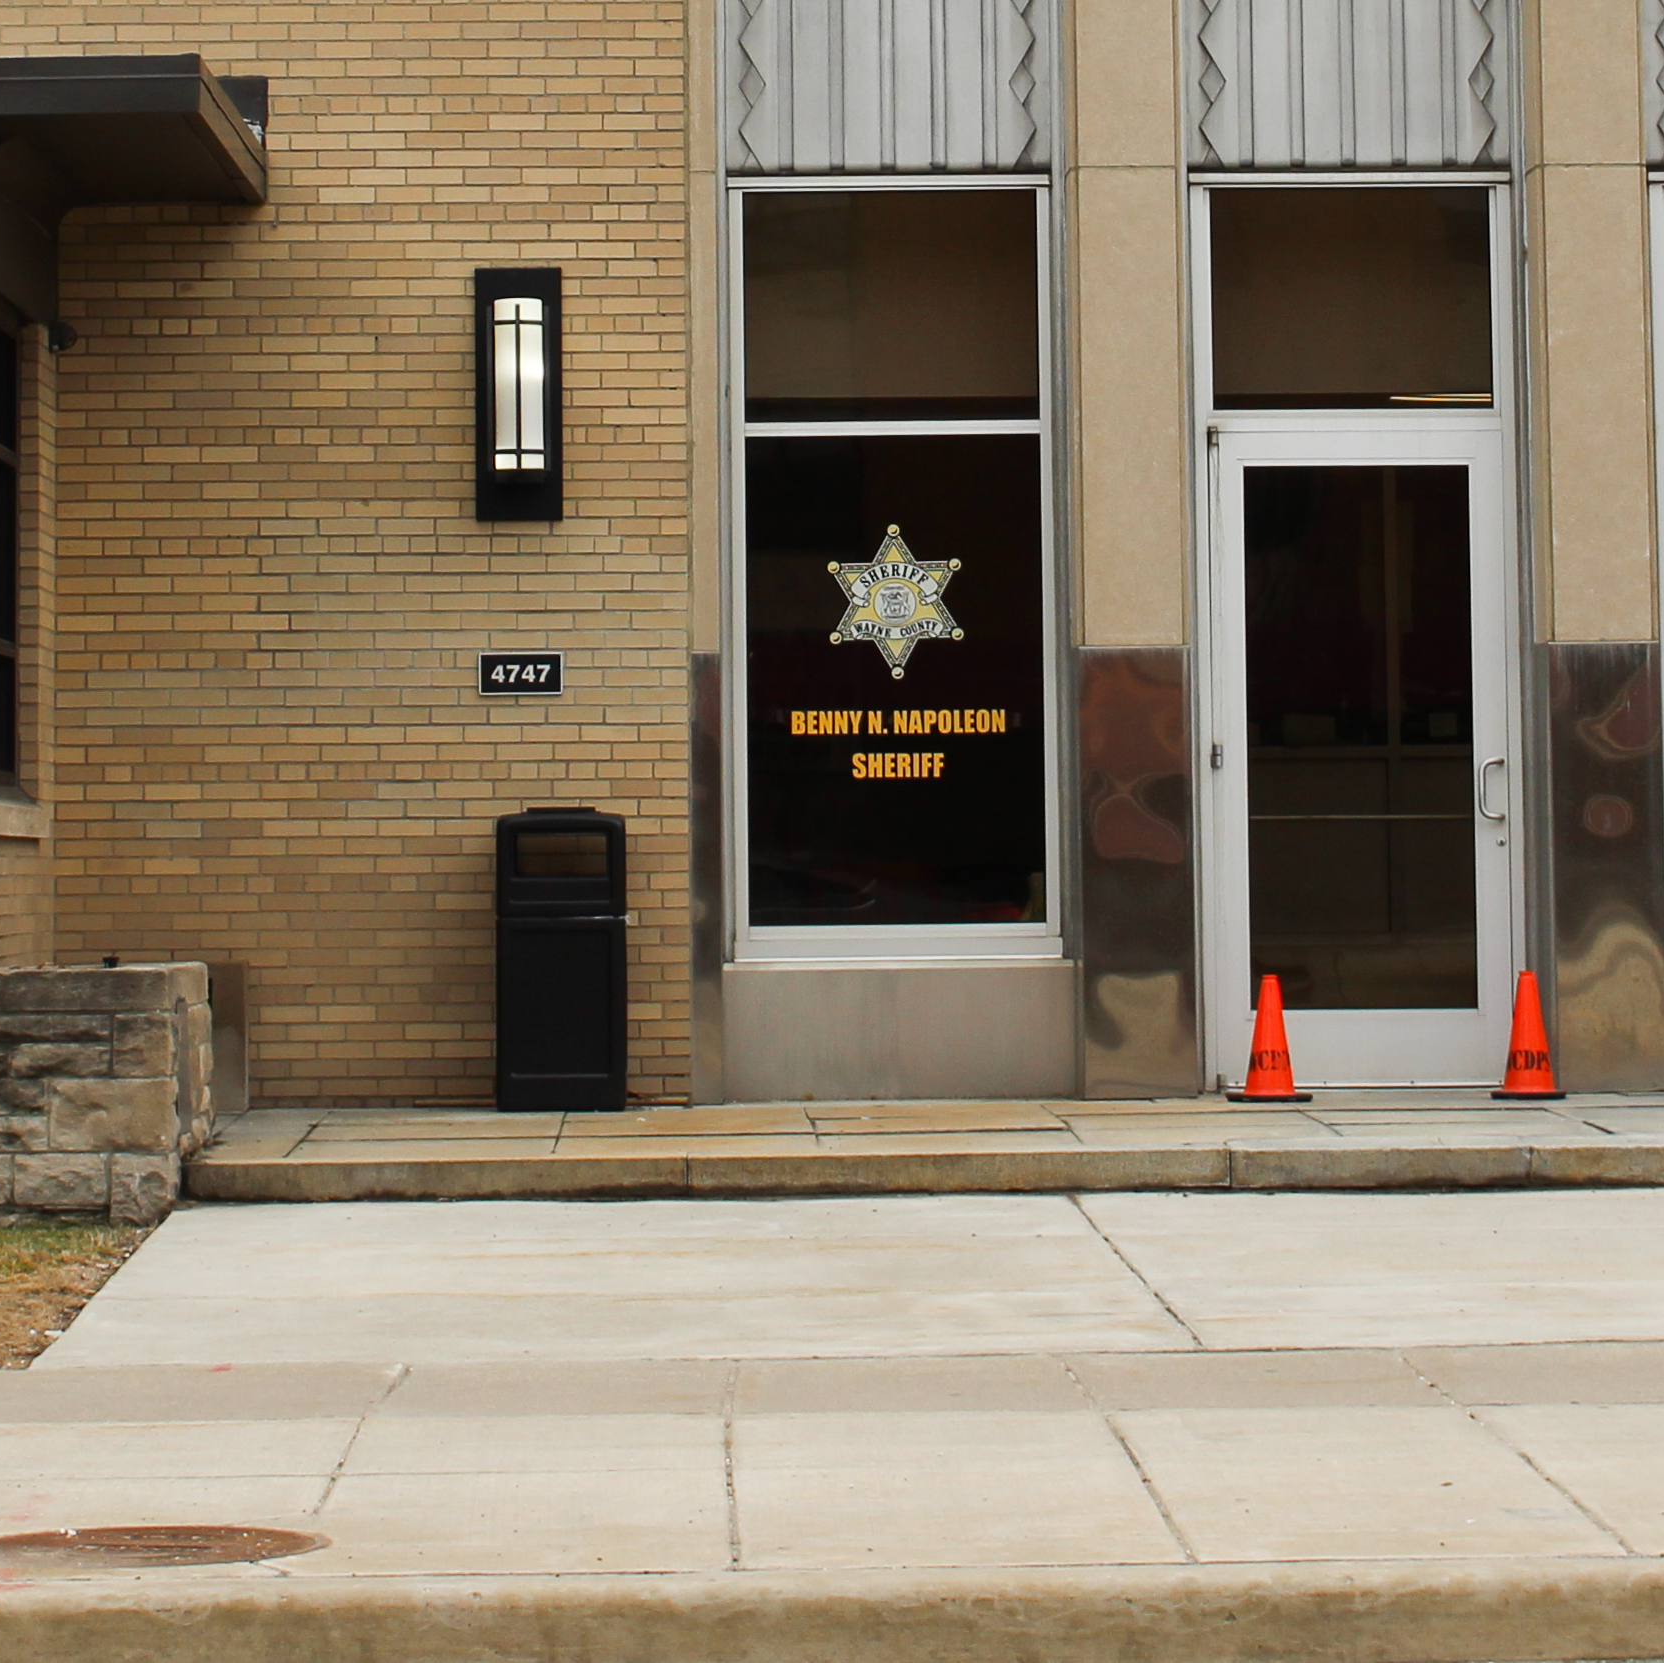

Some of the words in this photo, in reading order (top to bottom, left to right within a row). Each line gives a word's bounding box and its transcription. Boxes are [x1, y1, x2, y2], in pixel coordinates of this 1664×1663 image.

[859, 562, 929, 589] SHERIFF
[852, 622, 892, 638] WAYNE
[899, 621, 938, 637] COUNTY
[491, 664, 551, 683] 4747
[791, 710, 863, 735] BENNY
[868, 710, 888, 735] N.
[893, 709, 1006, 734] NAPOLEON
[852, 752, 945, 778] SHERIFF
